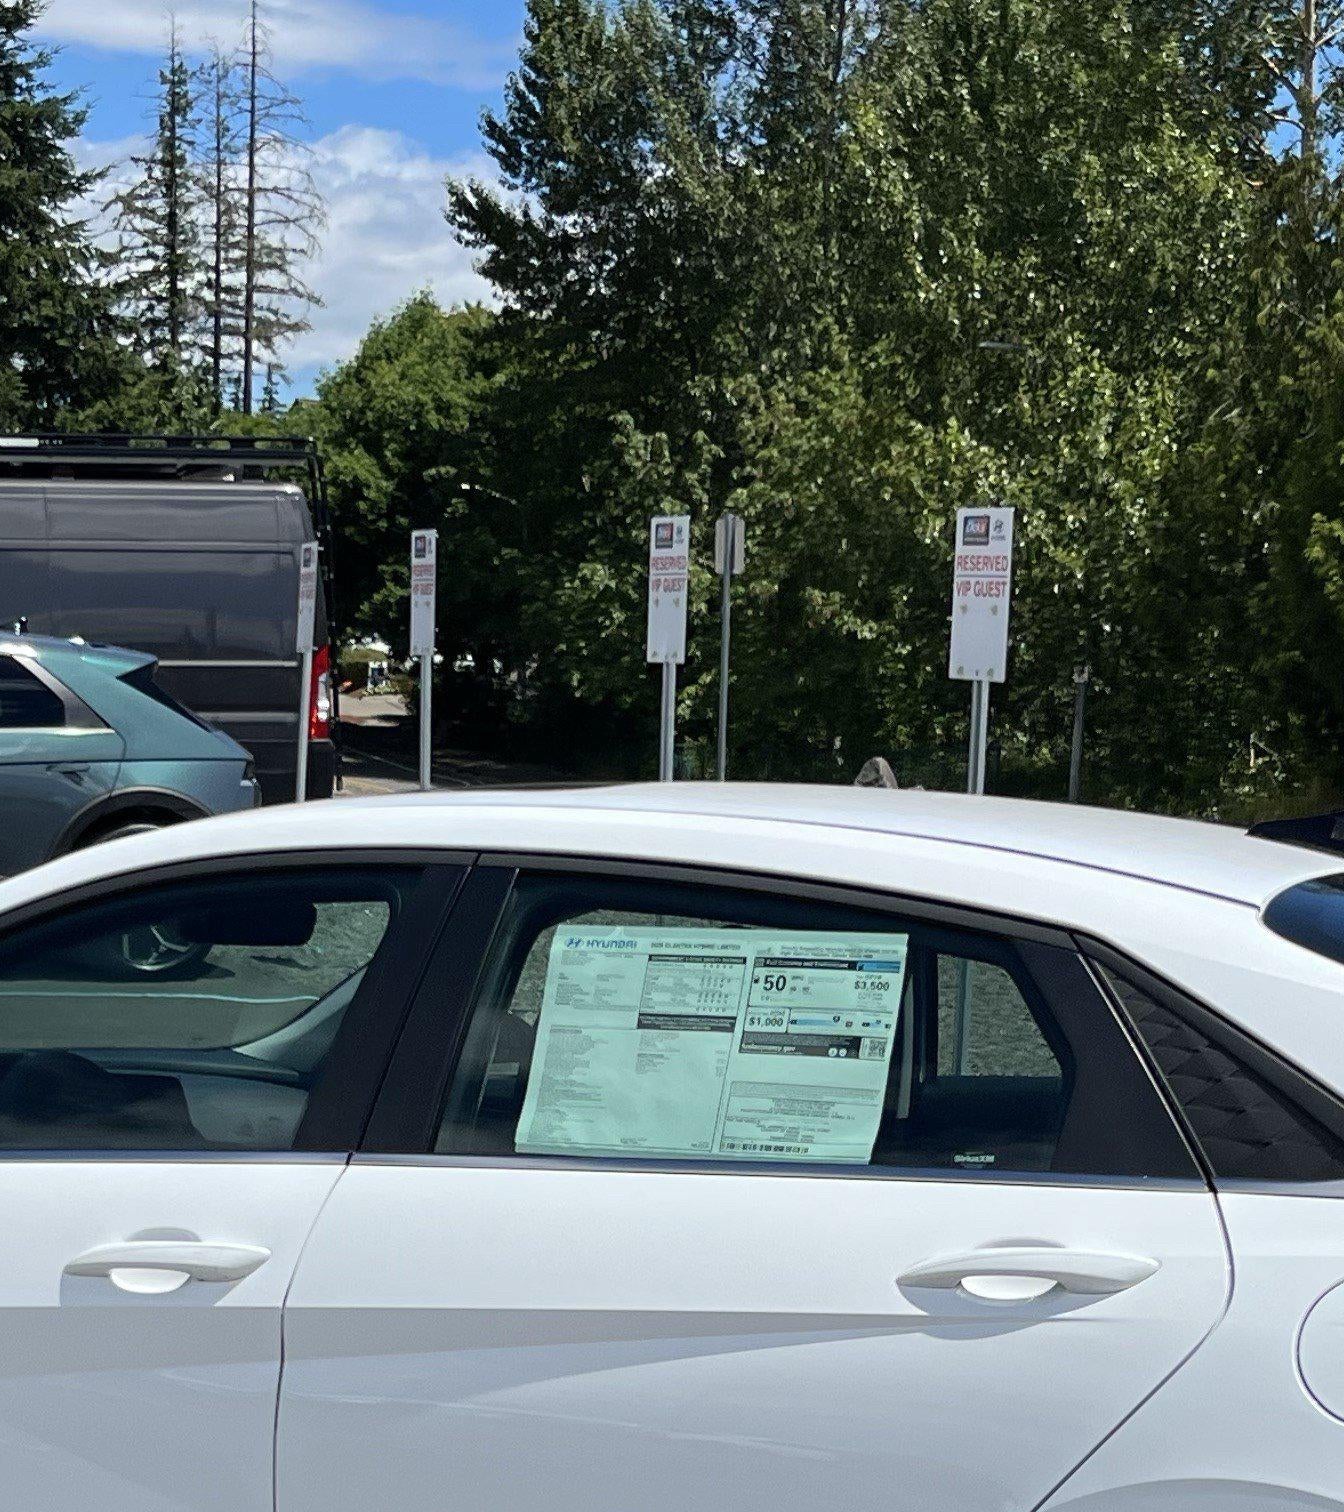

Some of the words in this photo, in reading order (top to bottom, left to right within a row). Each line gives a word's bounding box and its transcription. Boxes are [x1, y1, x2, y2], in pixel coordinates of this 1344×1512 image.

[956, 555, 1009, 572] RESERVED
[956, 580, 972, 598] VIP
[973, 580, 1008, 598] GUEST
[585, 939, 638, 950] HYUNDAI
[763, 974, 787, 992] 50
[854, 981, 890, 992] $3,500
[748, 1017, 783, 1028] $1,000
